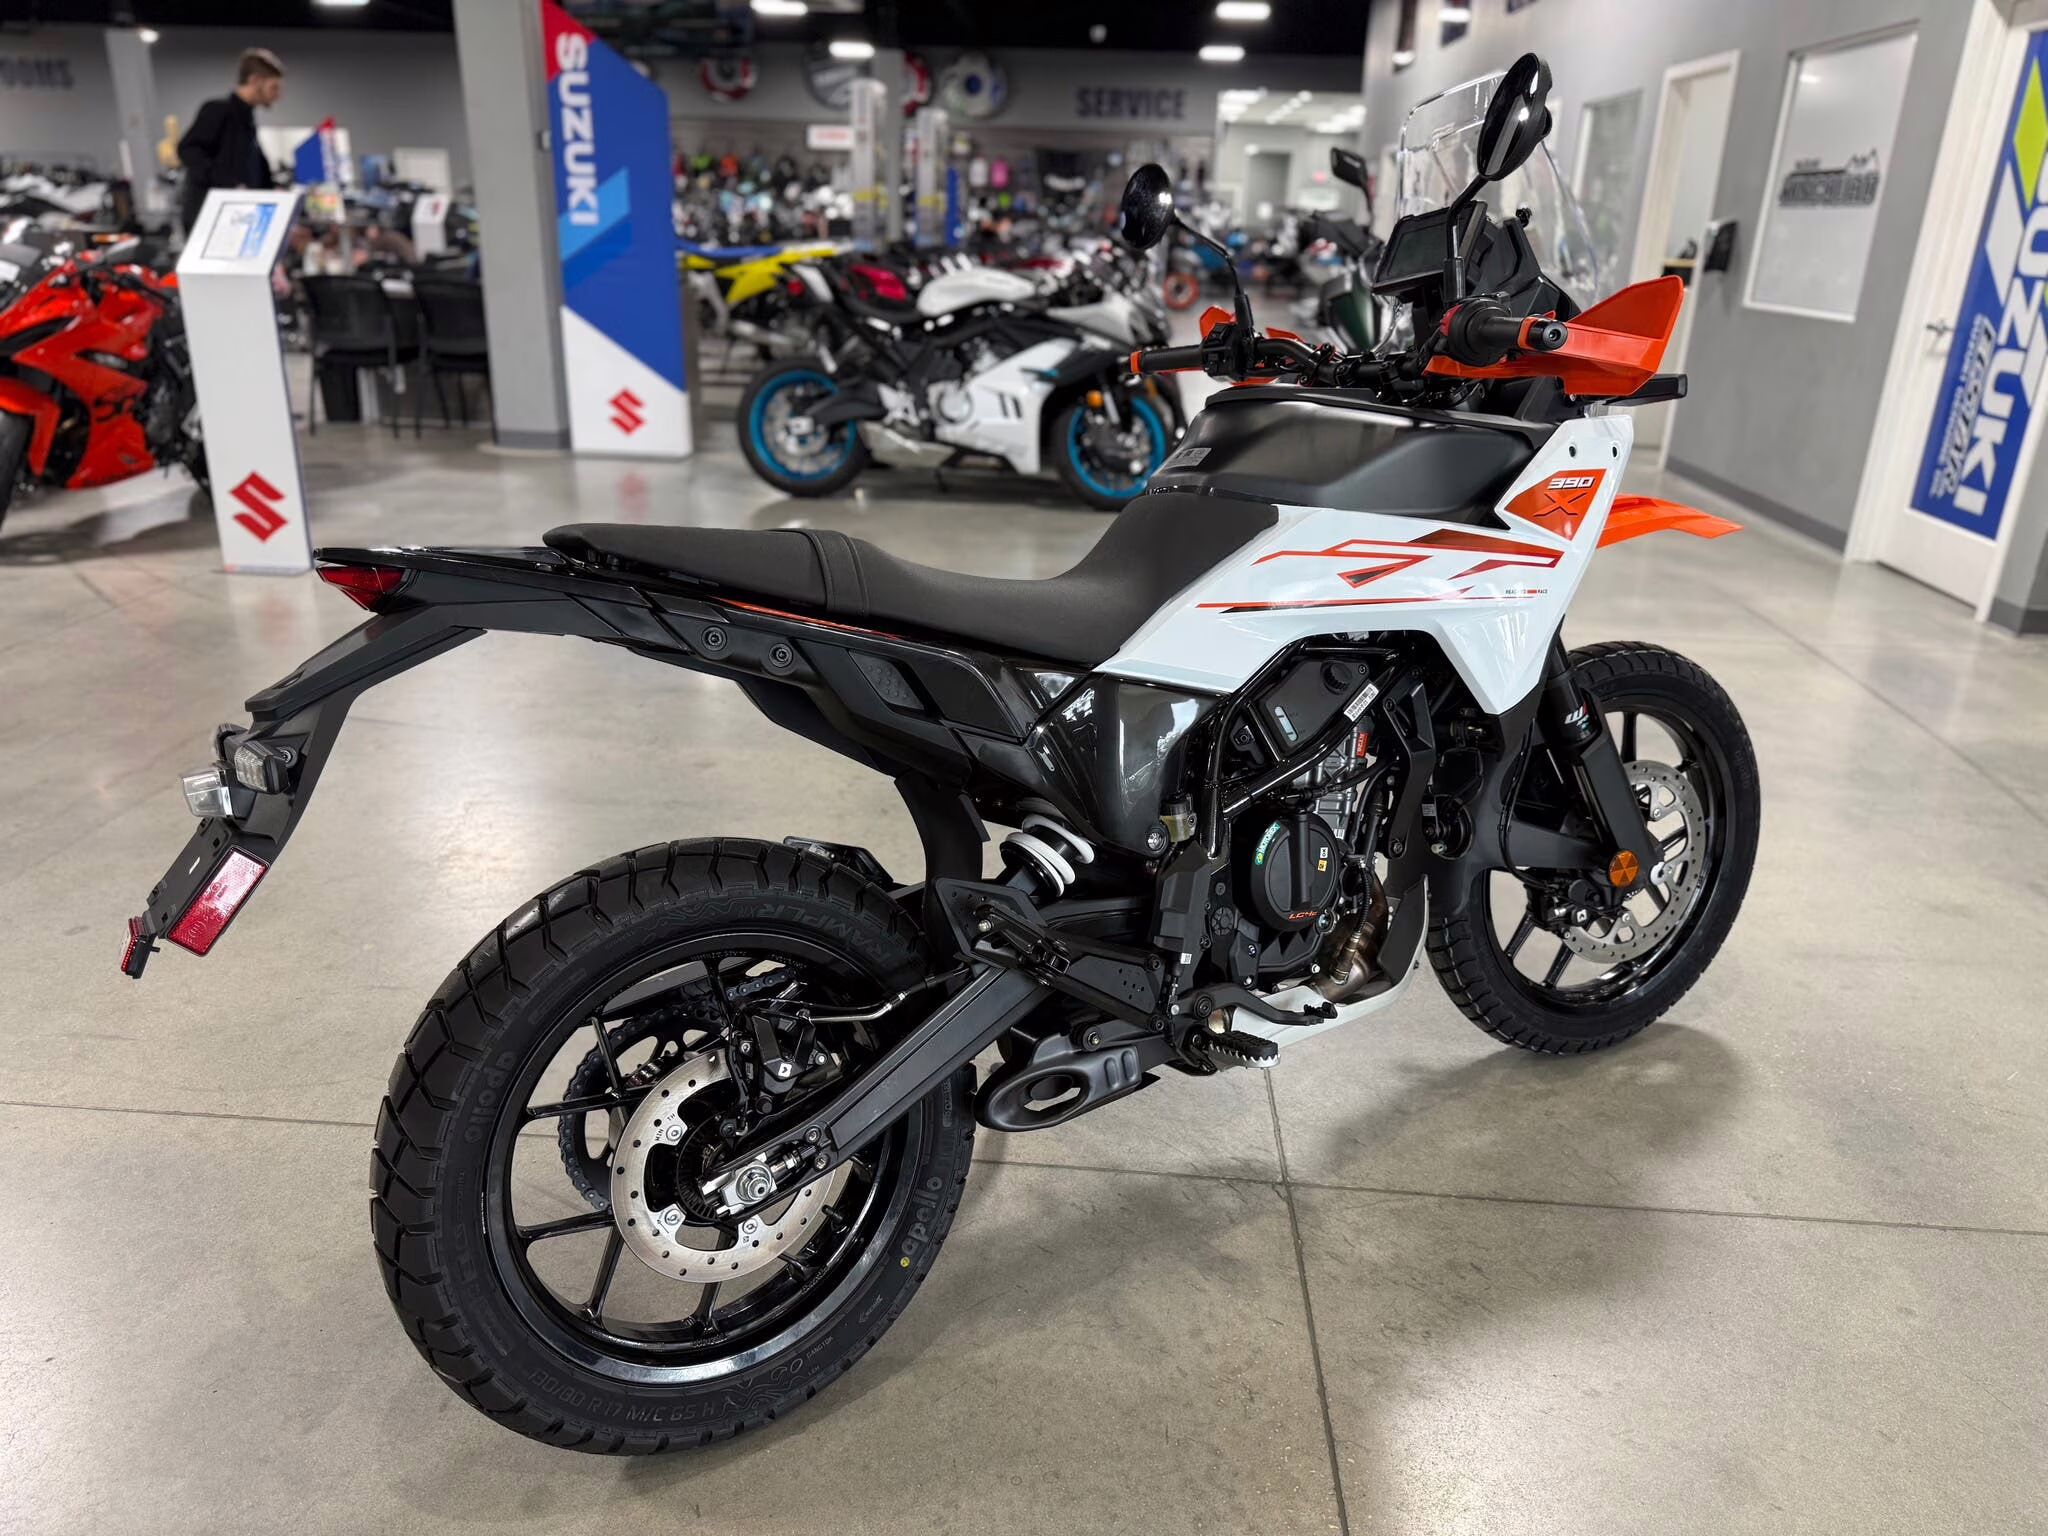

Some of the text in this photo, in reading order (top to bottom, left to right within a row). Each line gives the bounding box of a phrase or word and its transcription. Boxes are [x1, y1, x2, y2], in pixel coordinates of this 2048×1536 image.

[555, 32, 599, 225] SUZUKI
[1077, 86, 1187, 119] SERVICE
[1953, 152, 2048, 516] UZUKI
[1547, 476, 1595, 490] 390
[1258, 821, 1281, 854] MOTOREX
[464, 1049, 517, 1144] apollo
[901, 1175, 943, 1256] apollo
[805, 1335, 834, 1359] GANGTOK
